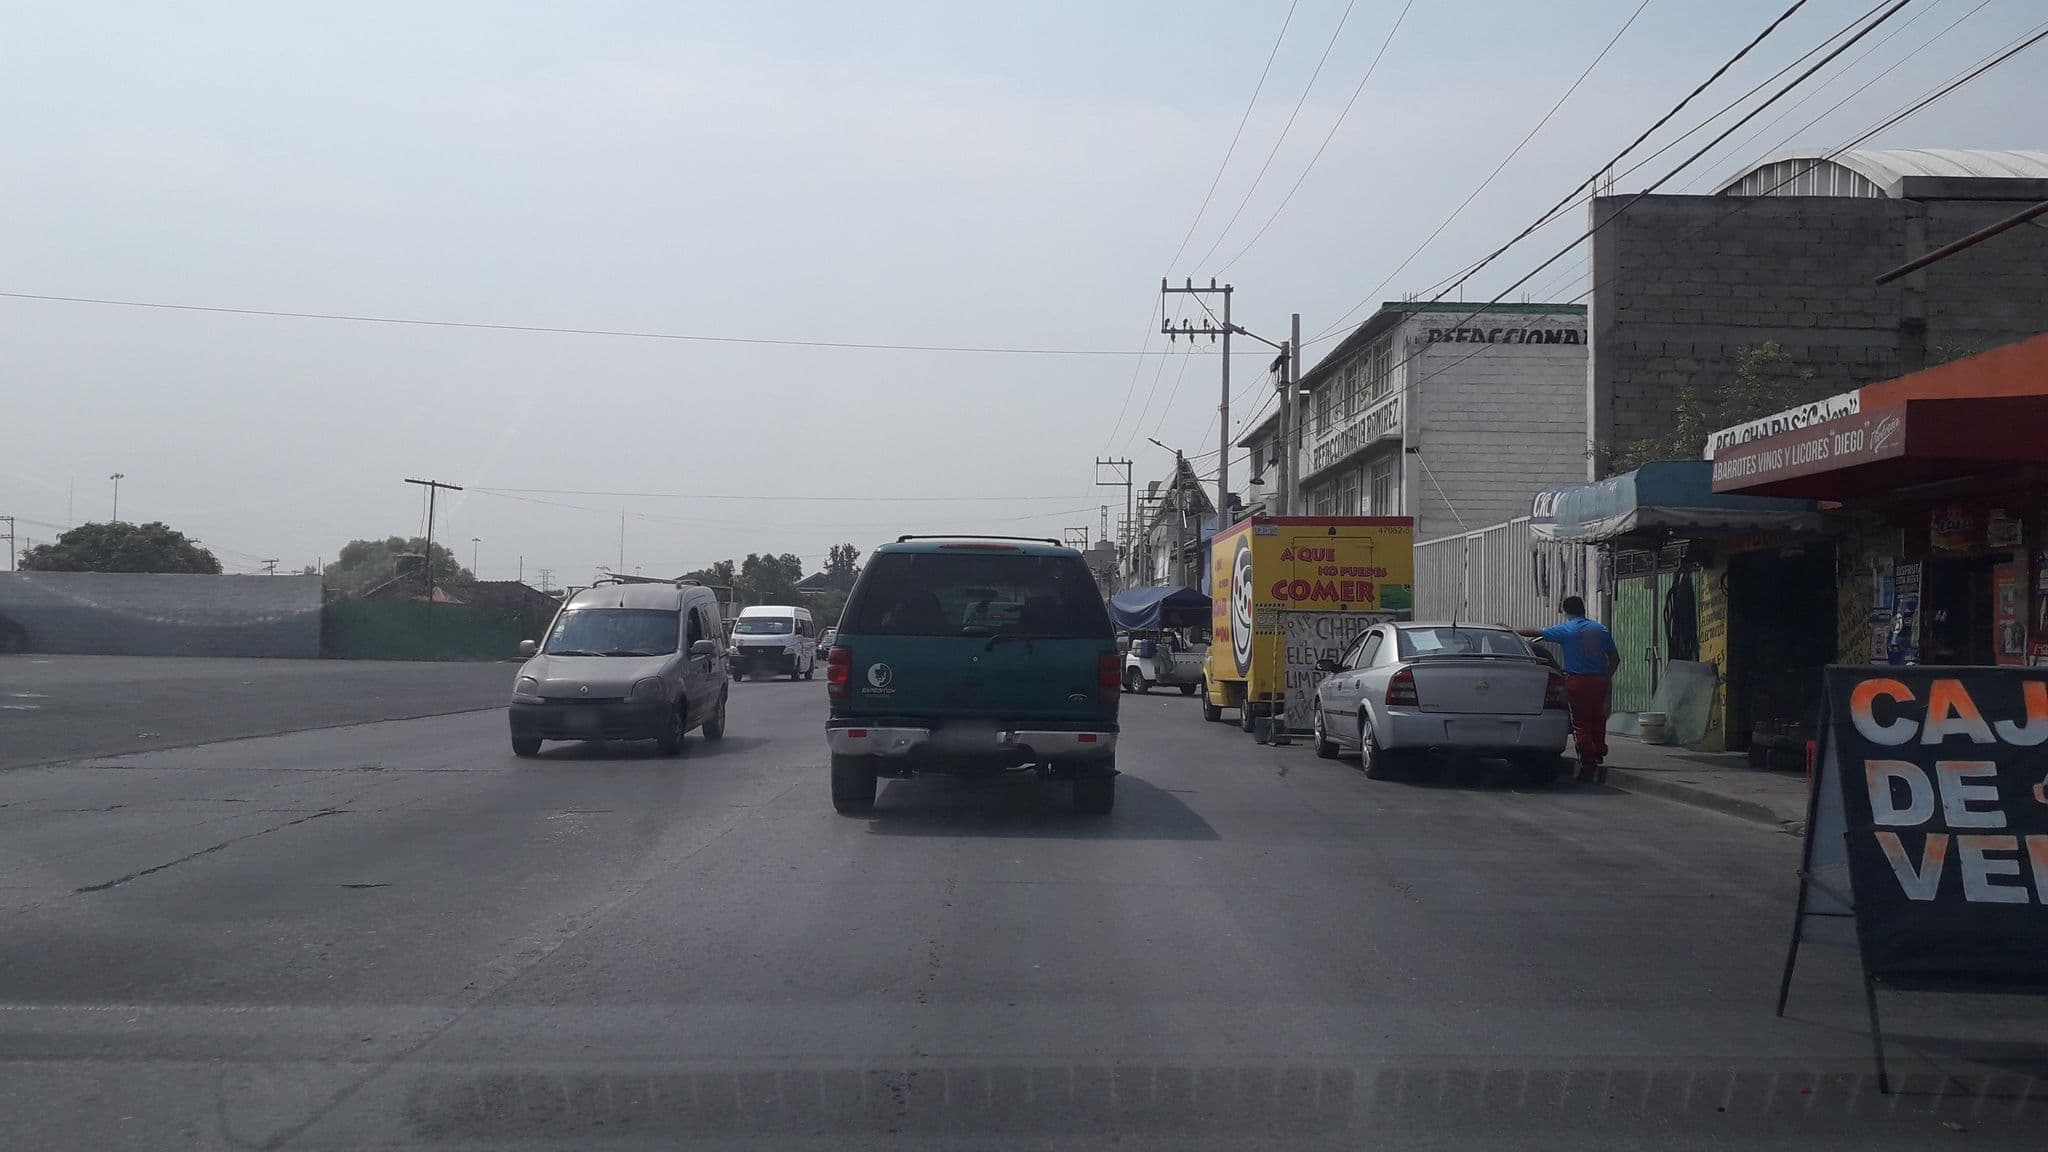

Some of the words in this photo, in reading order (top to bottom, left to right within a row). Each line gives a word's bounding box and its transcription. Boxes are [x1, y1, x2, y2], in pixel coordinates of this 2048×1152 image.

[1426, 328, 1588, 344] REFACCIONA
[1712, 454, 1757, 482] ABARROTES
[1758, 448, 1783, 473] VINOS
[1784, 447, 1790, 467] Y
[1792, 437, 1830, 466] LICORES
[1280, 547, 1294, 561] A
[1297, 546, 1336, 563] QUE
[1318, 565, 1338, 577] NO
[1340, 566, 1388, 578] PUEDES
[1271, 579, 1375, 603] COMER
[1864, 759, 2007, 828] DE
